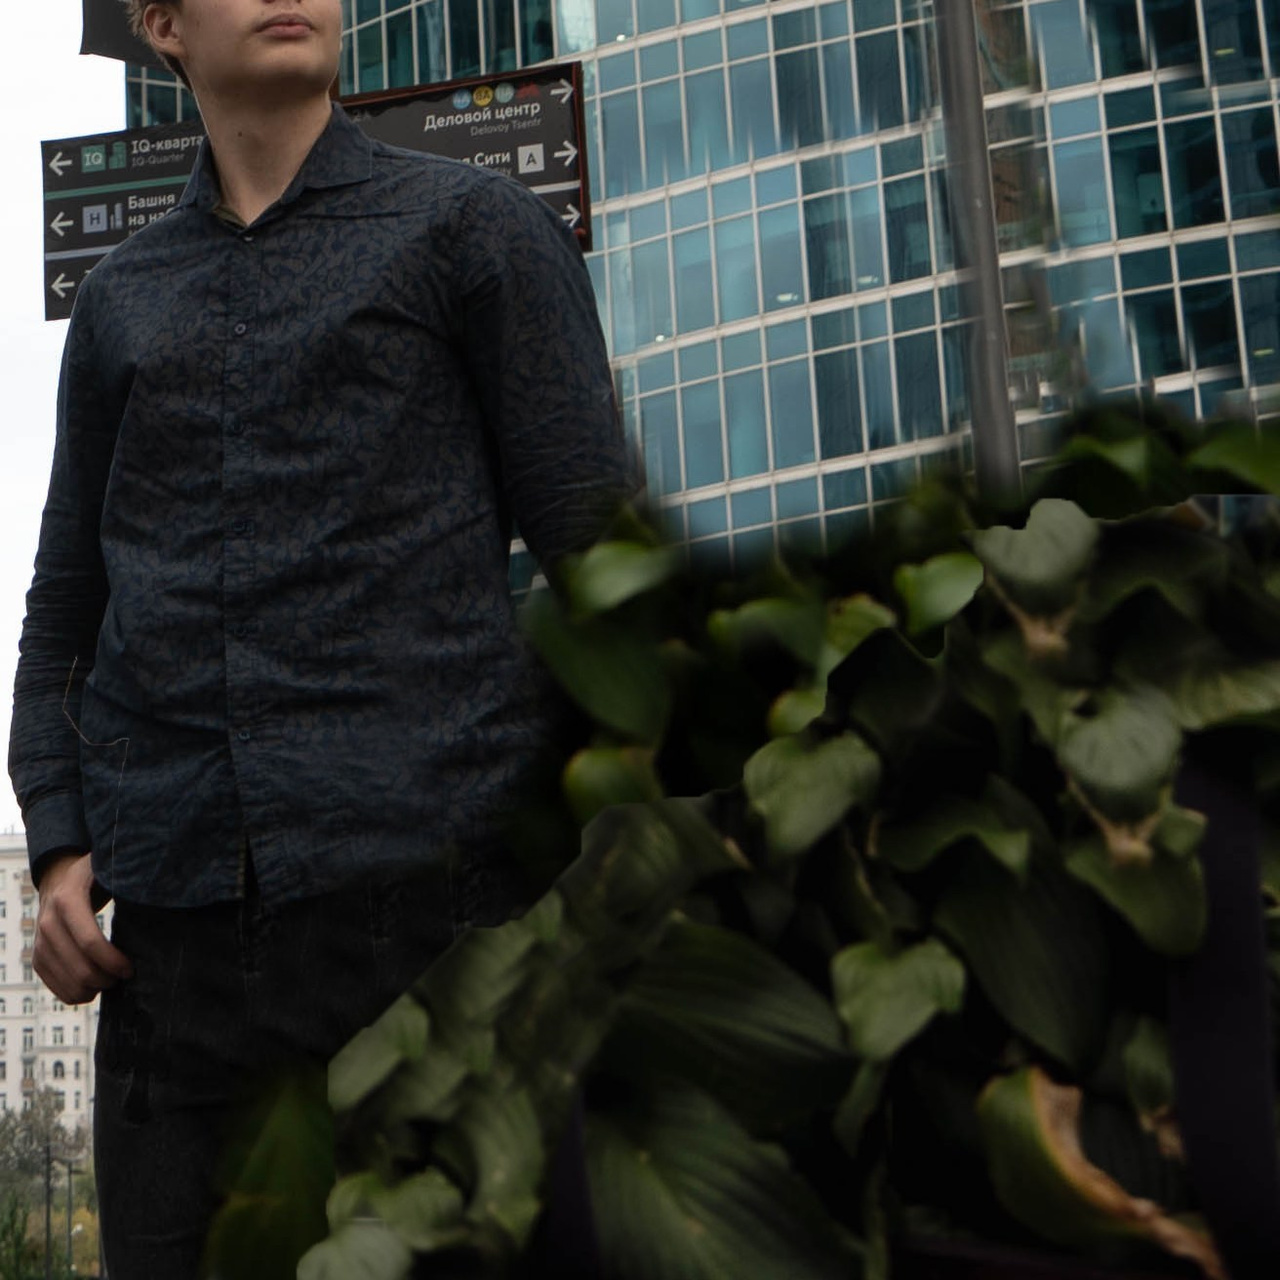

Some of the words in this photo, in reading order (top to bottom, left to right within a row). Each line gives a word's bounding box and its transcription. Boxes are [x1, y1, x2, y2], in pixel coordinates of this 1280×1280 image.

[423, 106, 491, 132] Деловой
[495, 102, 541, 121] центр
[131, 135, 204, 154] IQ-кварта
[84, 152, 103, 166] IQ
[131, 153, 185, 167] IQ-Quarter
[474, 151, 510, 166] Сити
[128, 193, 175, 210] Башня
[128, 213, 145, 226] на
